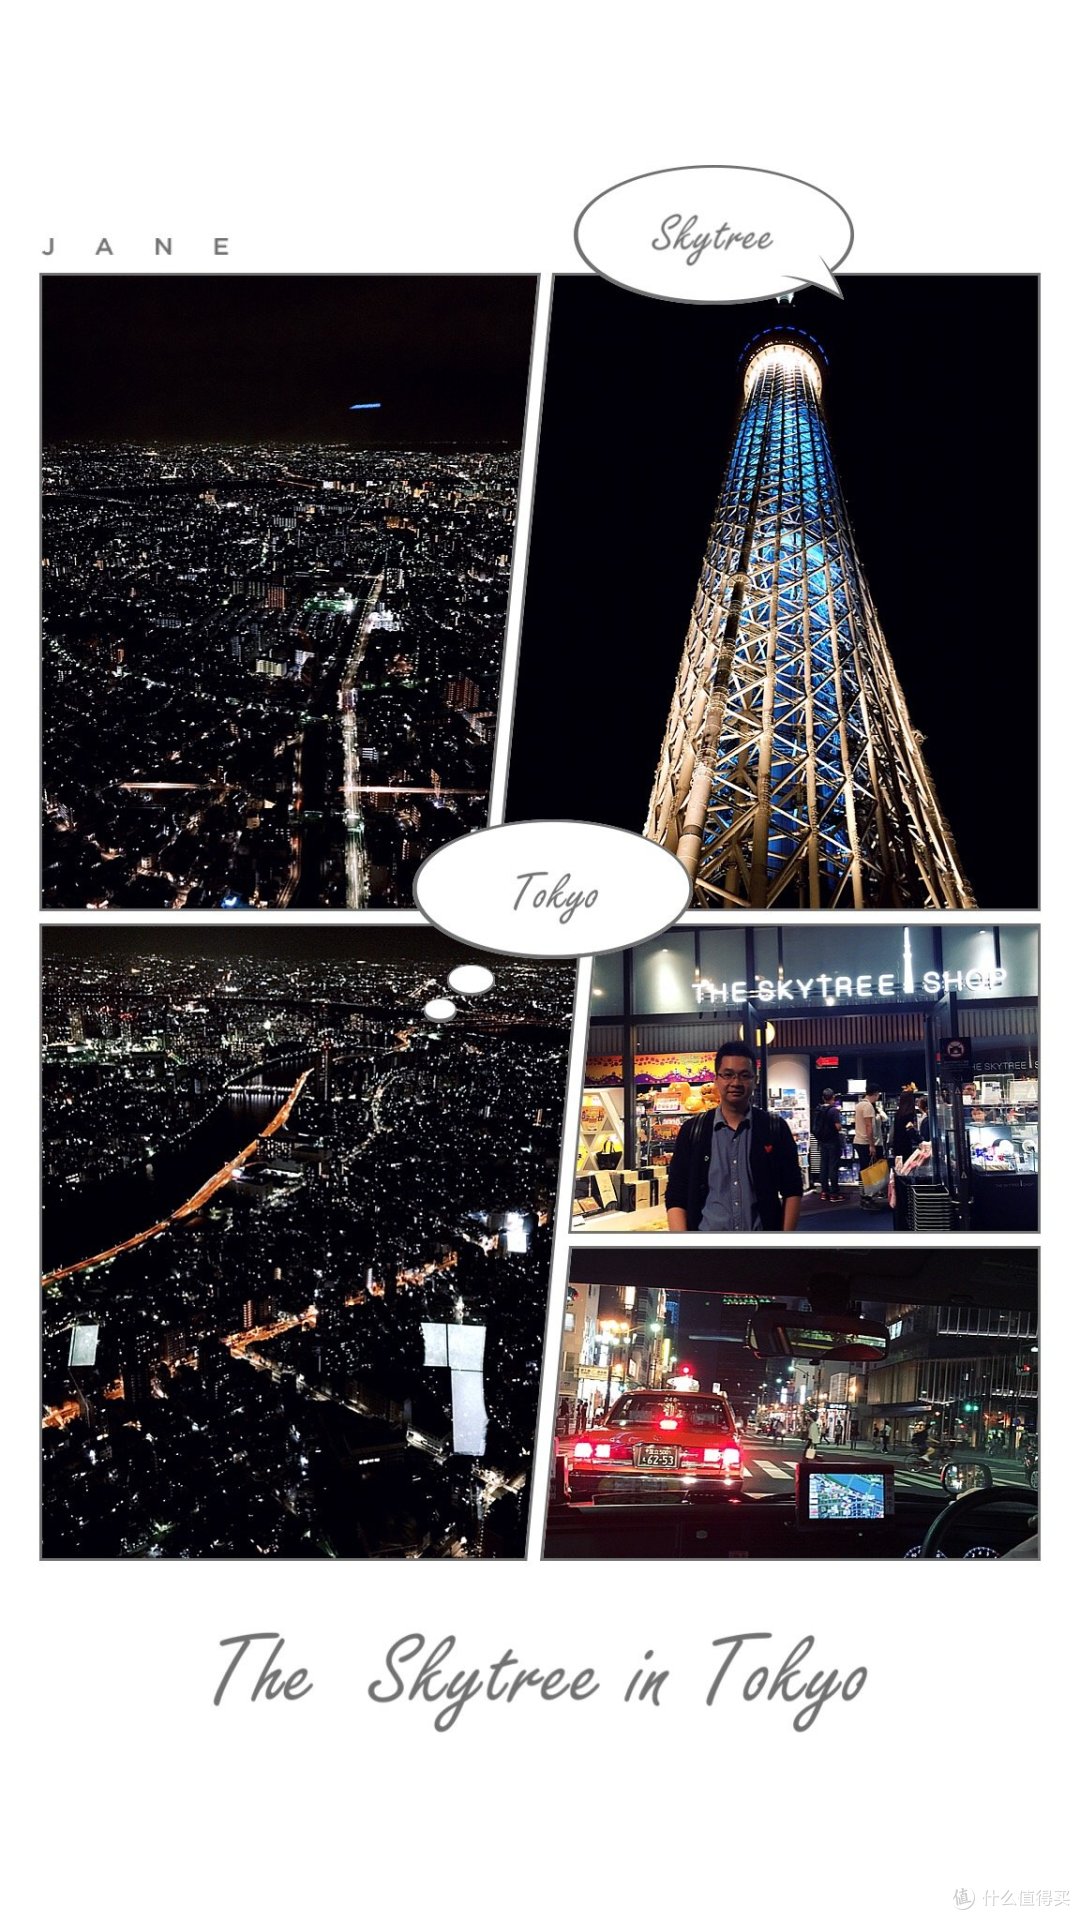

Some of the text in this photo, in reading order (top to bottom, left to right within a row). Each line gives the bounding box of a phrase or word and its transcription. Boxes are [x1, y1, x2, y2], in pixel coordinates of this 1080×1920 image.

[692, 967, 1007, 1004] THE SKYTREE SHOP
[984, 1061, 1027, 1071] SKYTREE
[647, 1454, 674, 1465] 62-53
